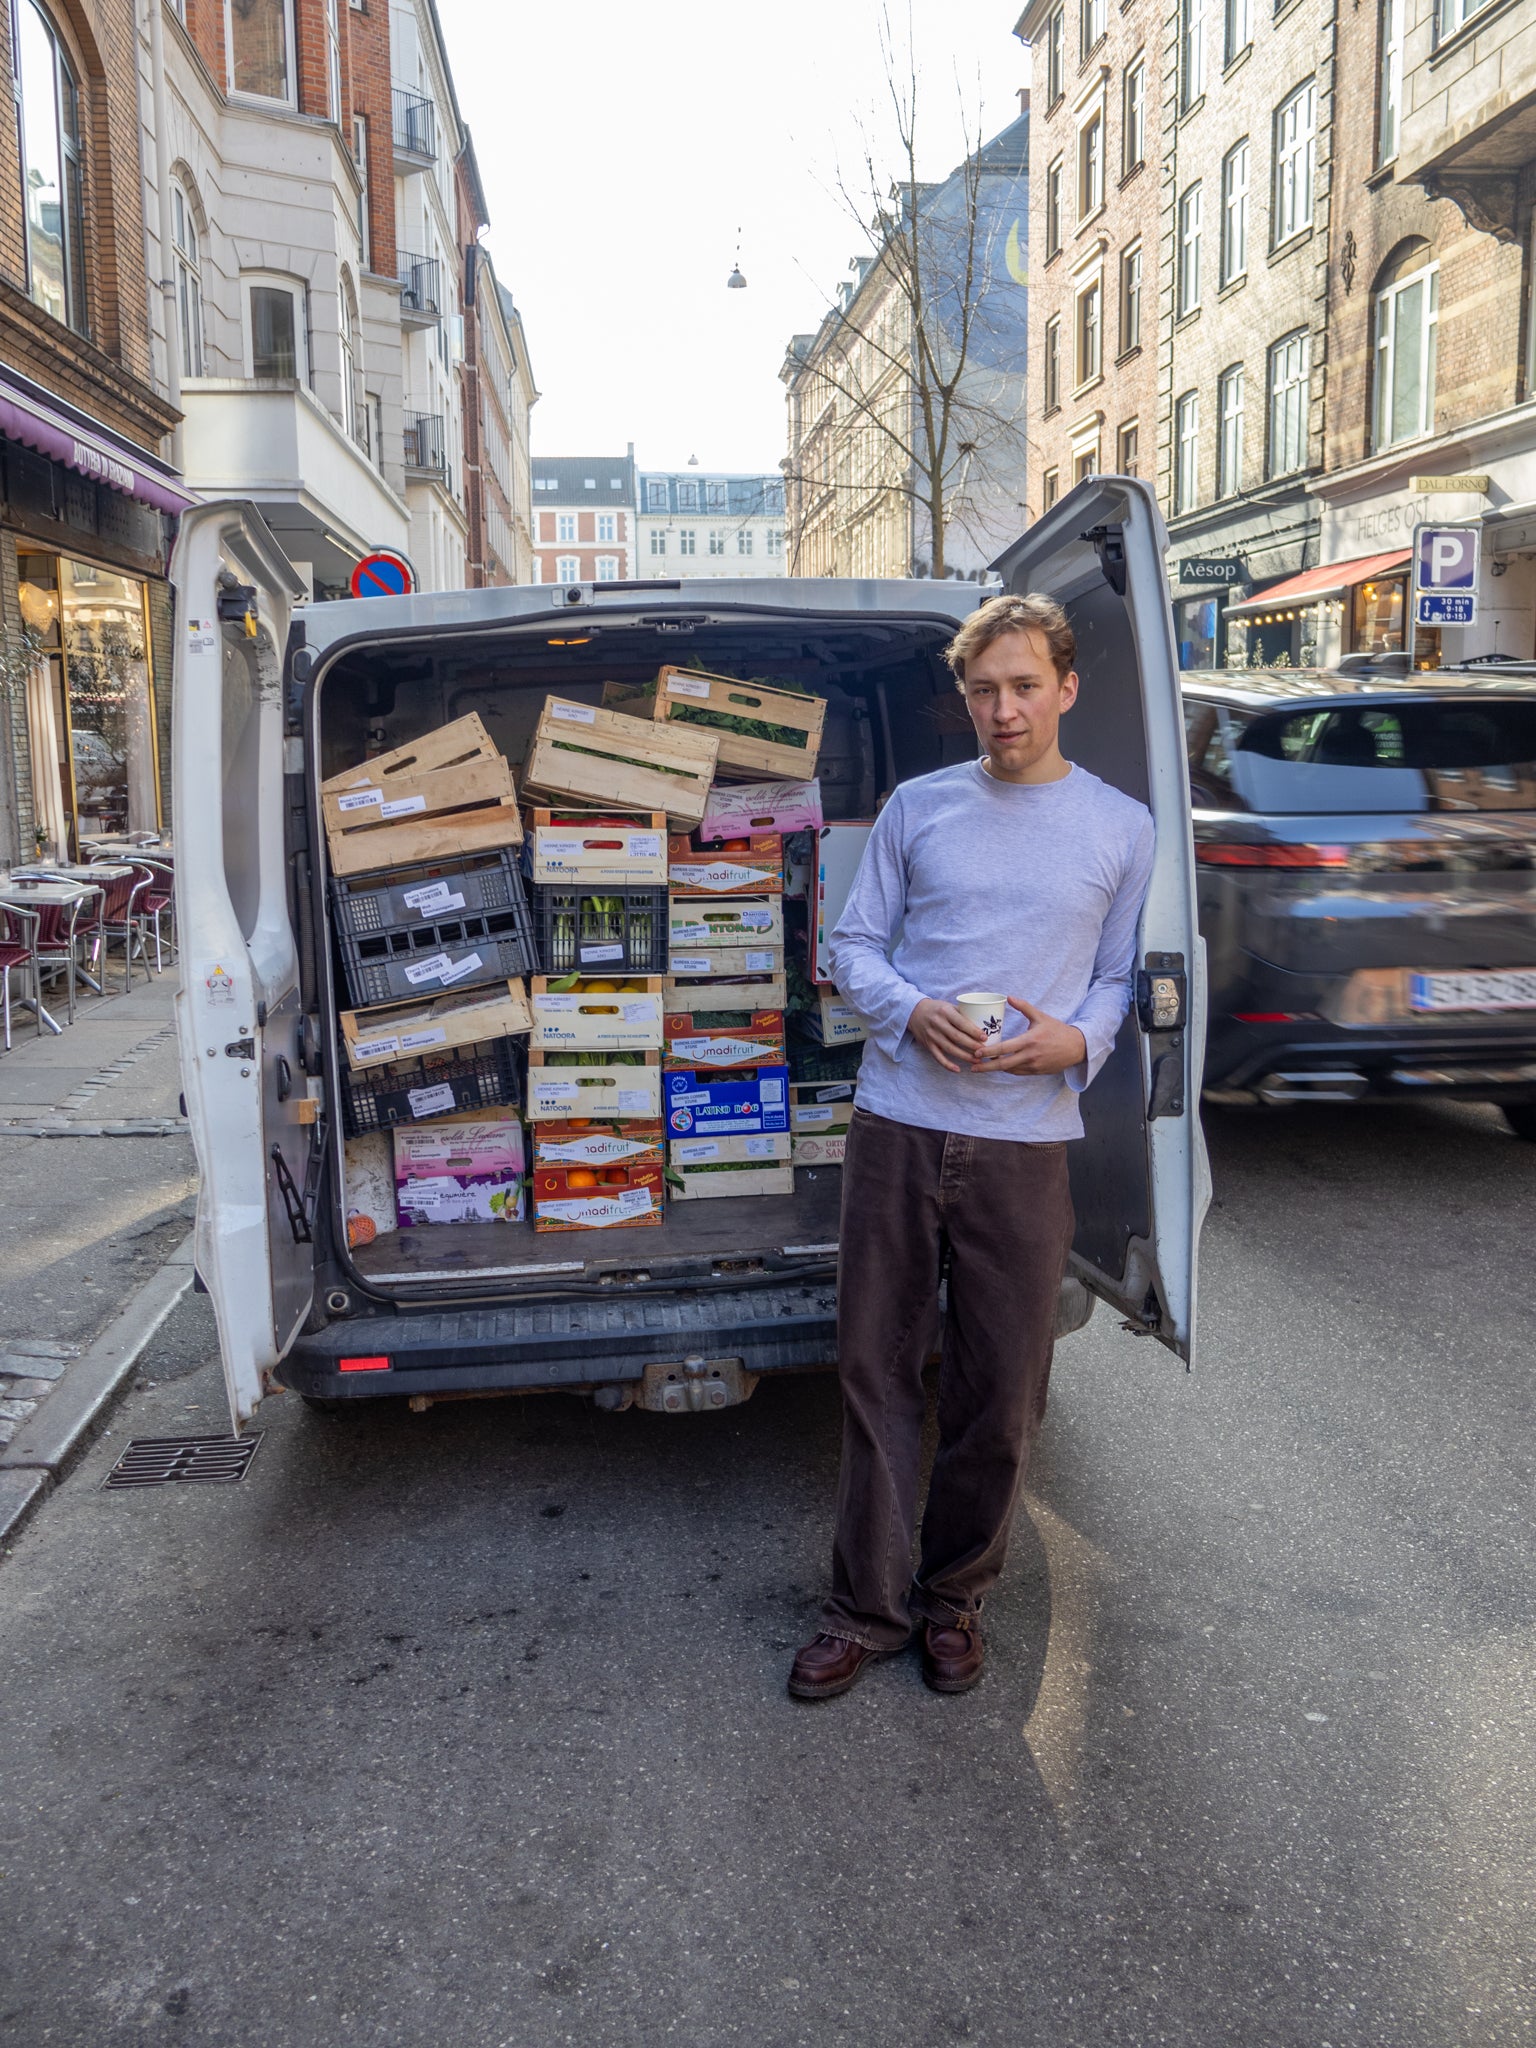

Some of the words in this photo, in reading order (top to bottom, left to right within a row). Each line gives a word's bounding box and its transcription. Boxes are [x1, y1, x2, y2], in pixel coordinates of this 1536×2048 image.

[1418, 479, 1441, 489] DAL
[1445, 479, 1488, 489] FORNO
[1358, 505, 1401, 540] HELGES
[1431, 536, 1464, 583] P
[1183, 562, 1236, 581] Aēsop
[704, 869, 750, 880] adifruit
[685, 921, 754, 934] DNTONA
[706, 1045, 754, 1055] madifruit
[696, 1105, 730, 1116] LATINO
